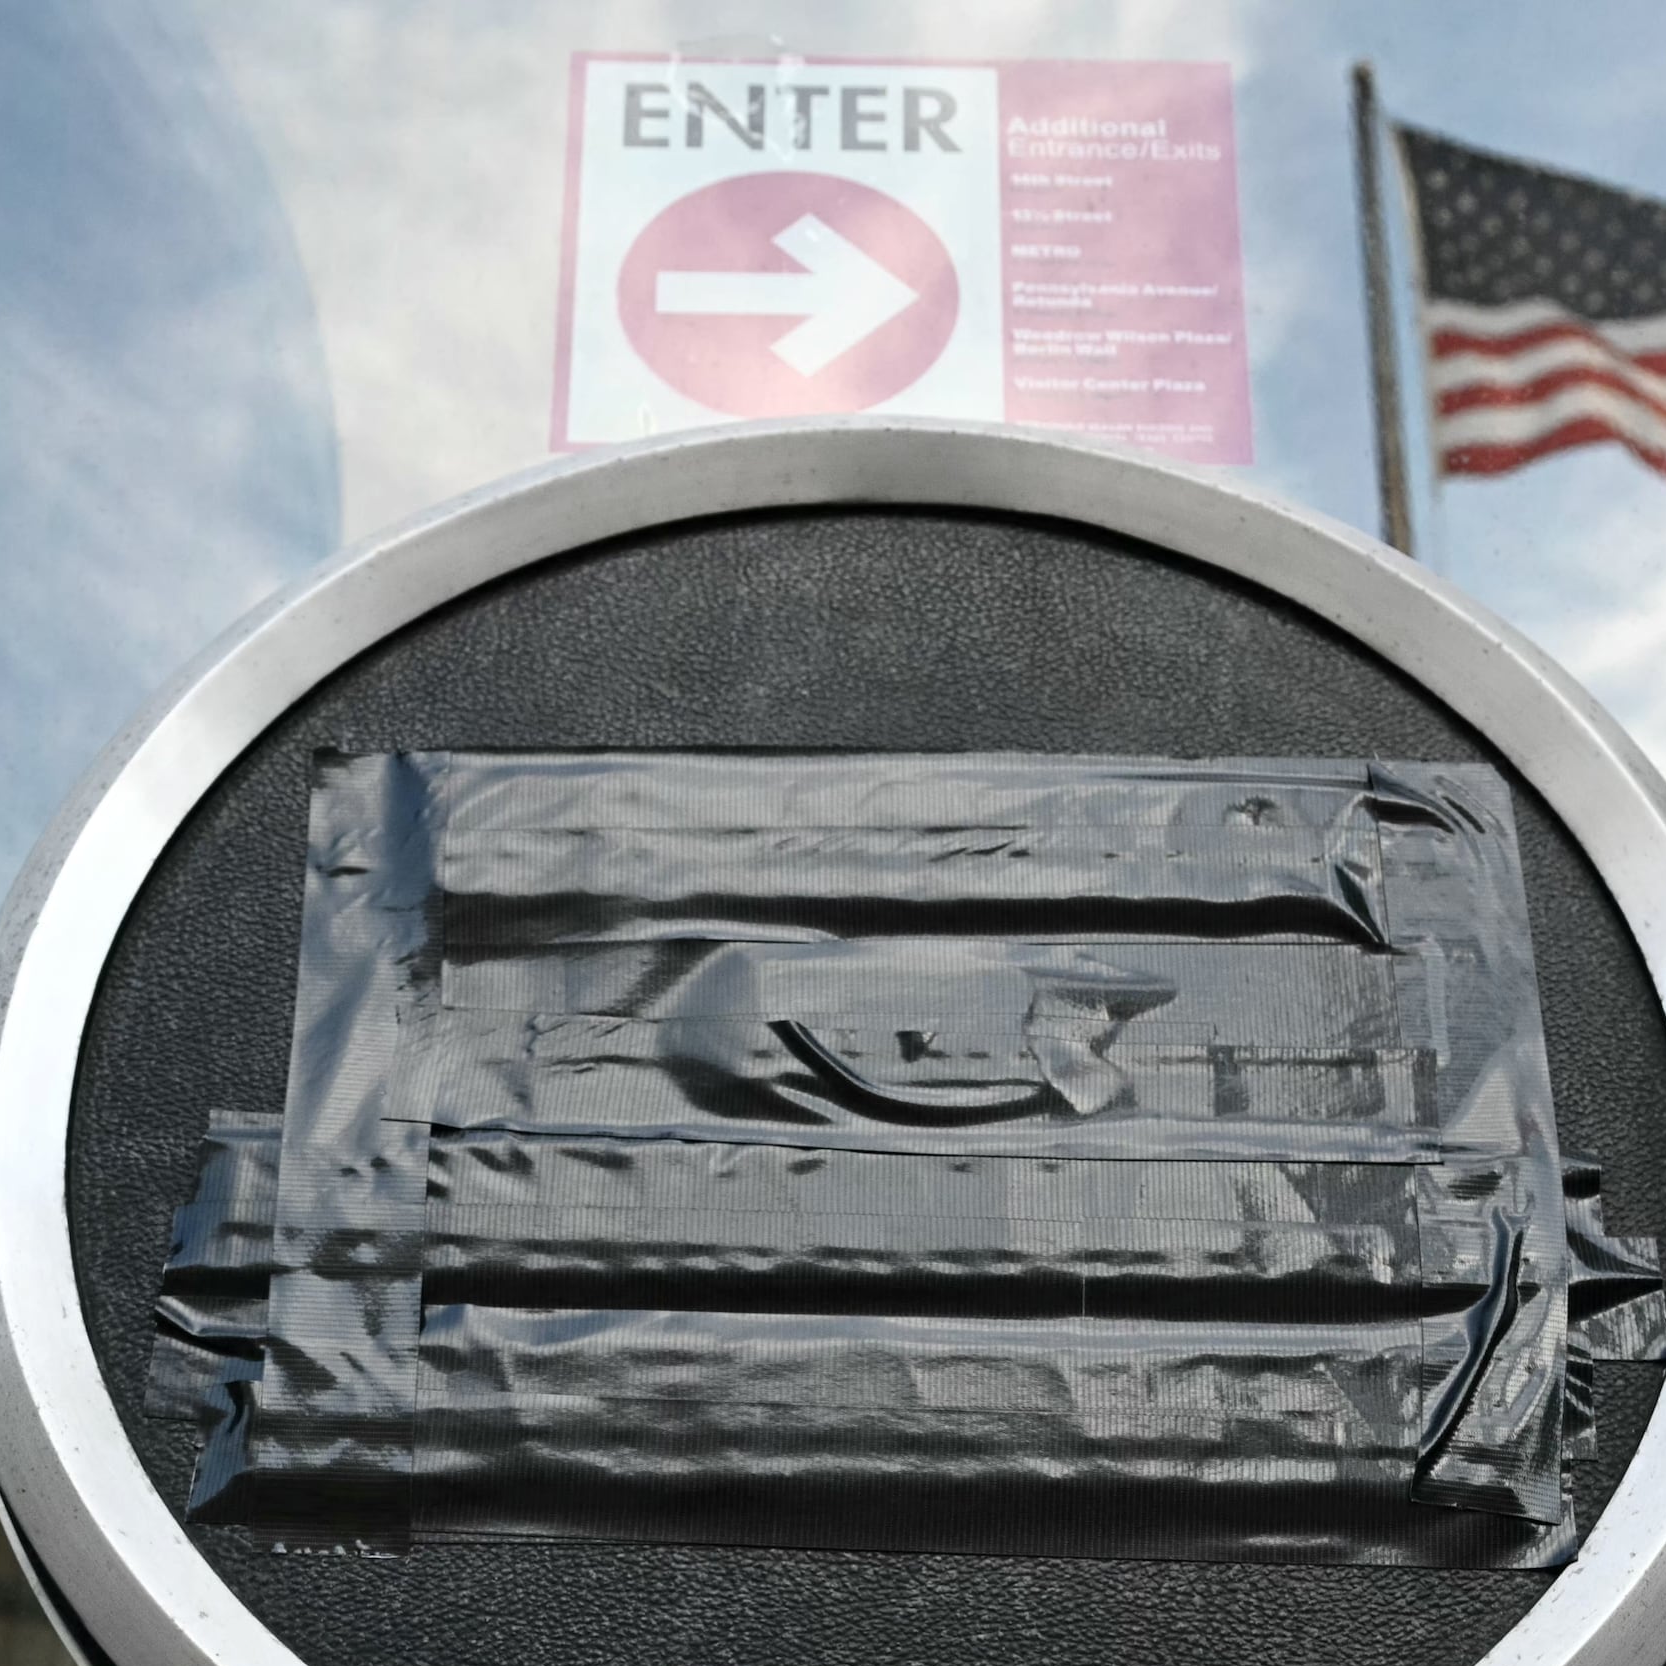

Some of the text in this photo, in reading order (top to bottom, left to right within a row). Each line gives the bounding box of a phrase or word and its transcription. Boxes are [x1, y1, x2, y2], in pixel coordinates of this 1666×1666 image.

[621, 81, 963, 153] ENTER
[1006, 115, 1167, 138] Additional
[1007, 138, 1222, 161] Entrance/Exits
